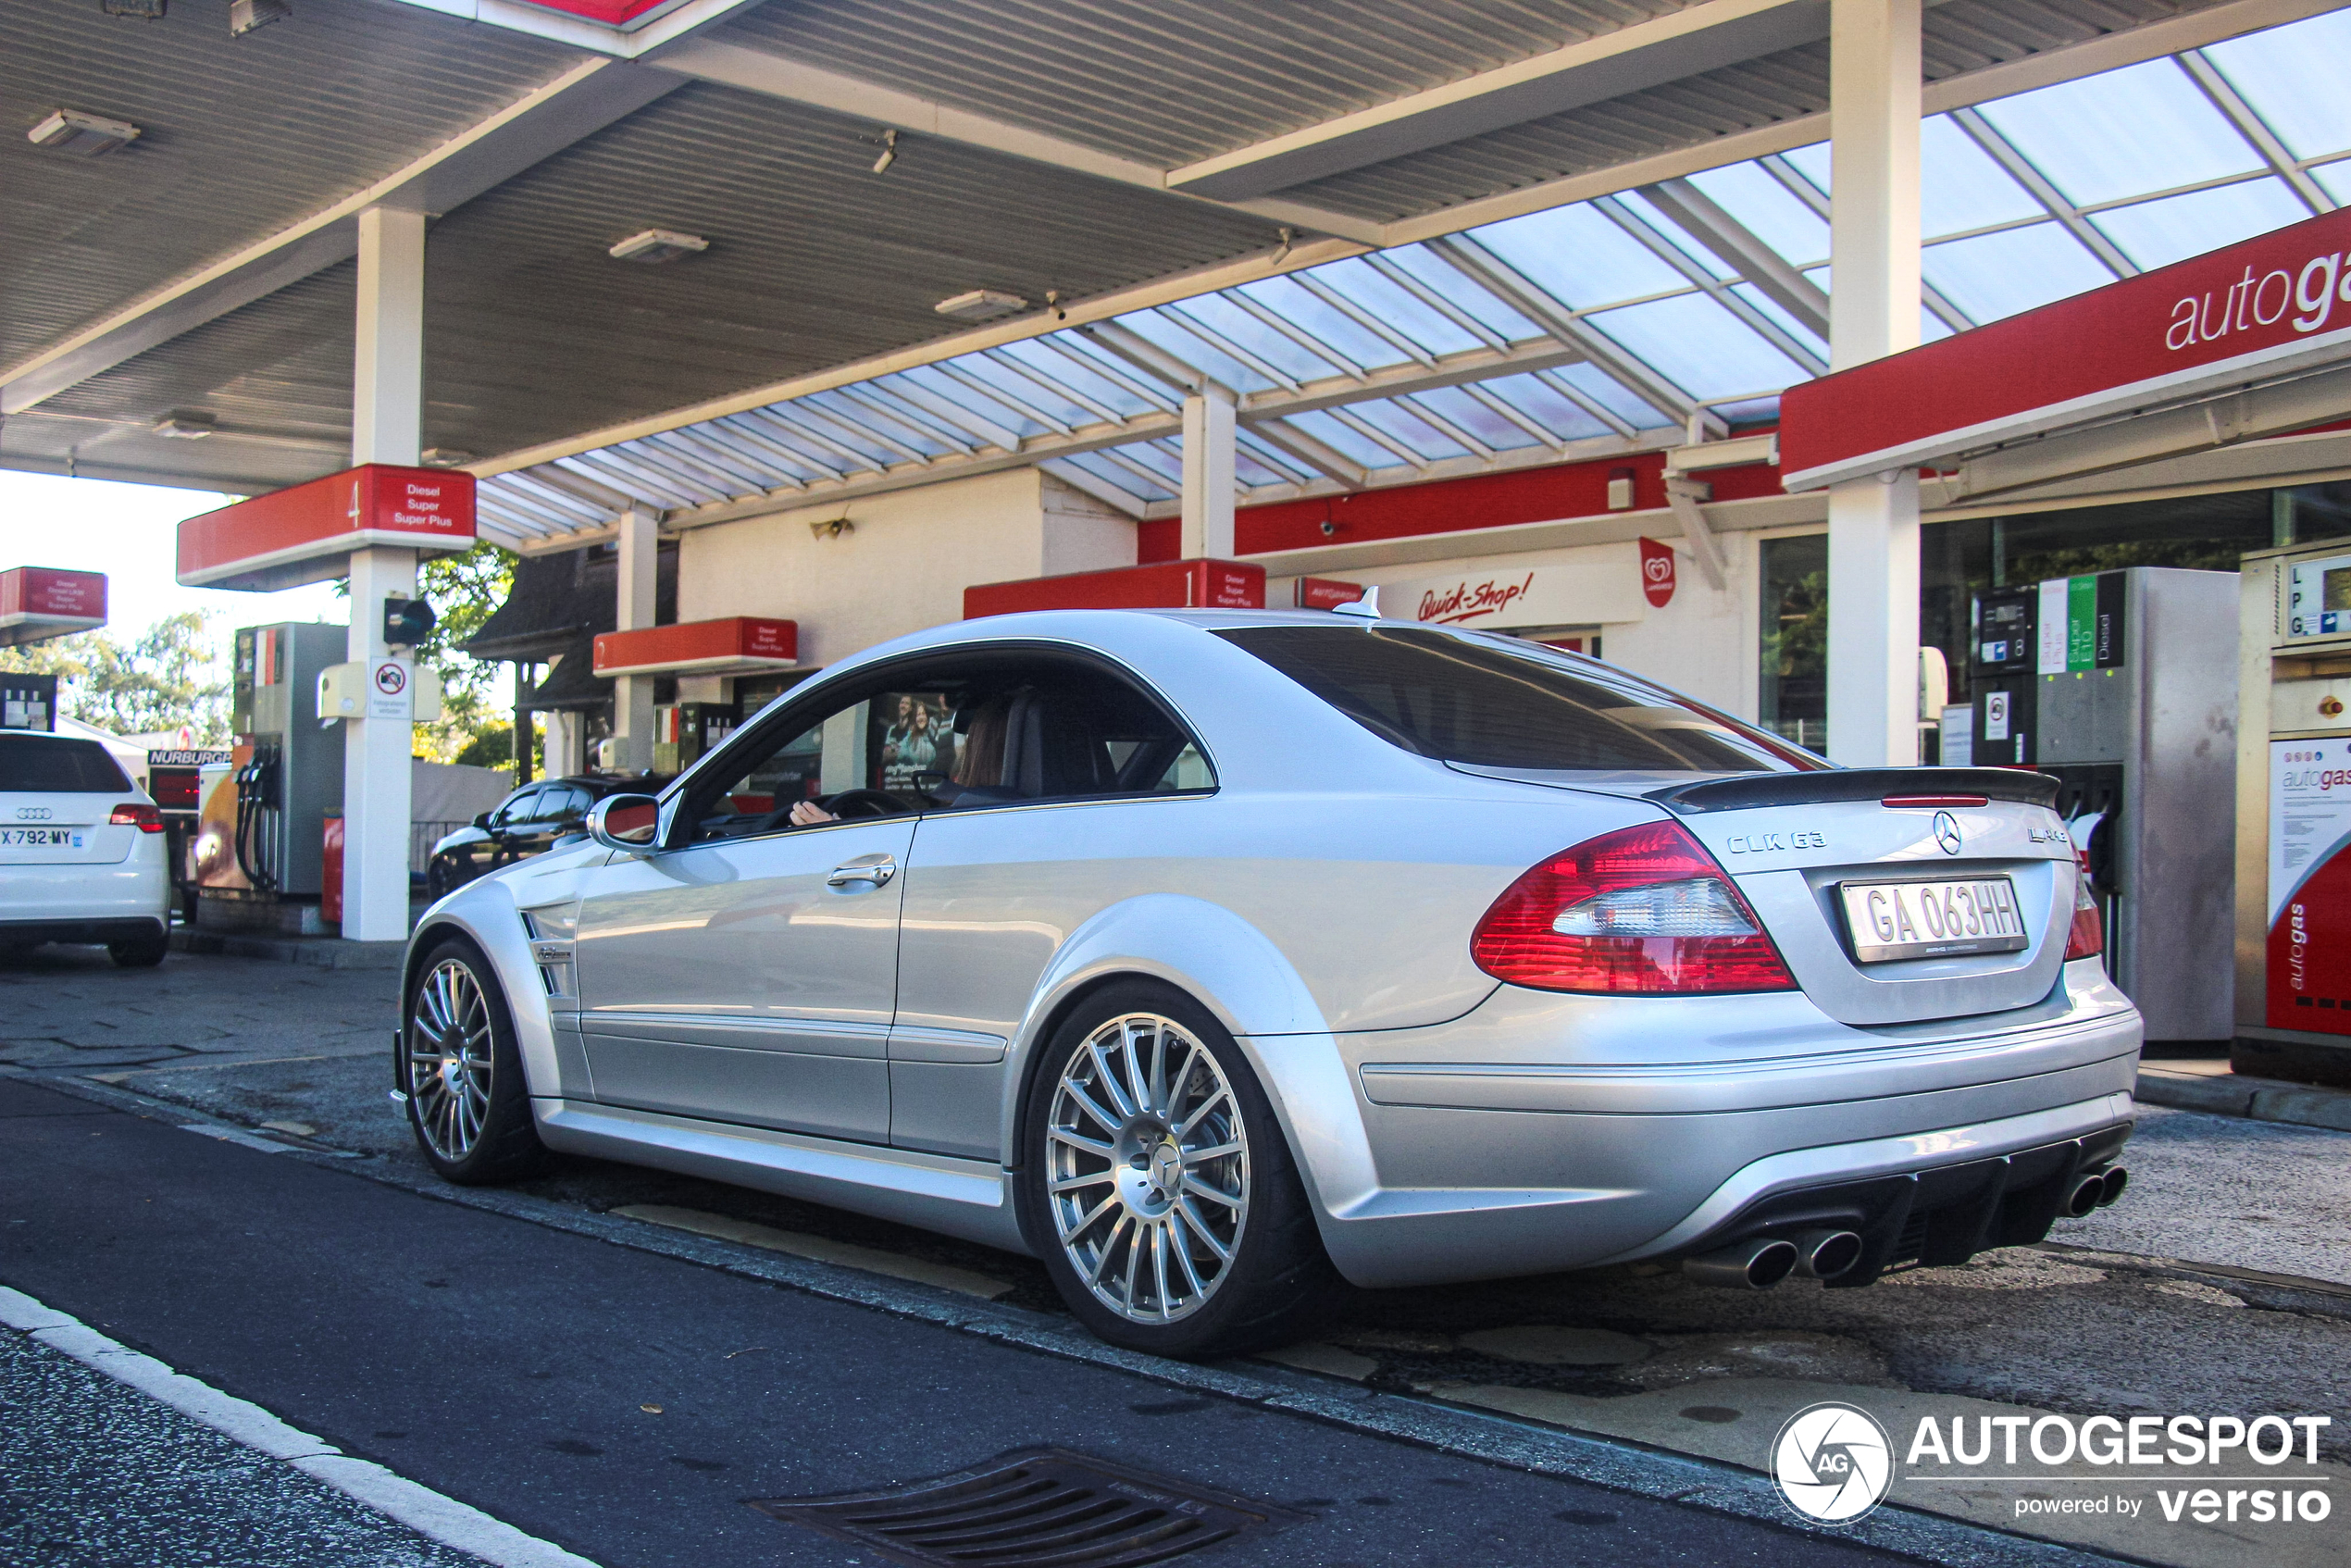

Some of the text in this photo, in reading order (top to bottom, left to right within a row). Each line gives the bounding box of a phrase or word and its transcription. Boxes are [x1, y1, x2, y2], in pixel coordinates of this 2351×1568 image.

[406, 484, 441, 496] Diesel
[348, 480, 360, 528] 4
[407, 498, 440, 511] Super
[394, 512, 453, 528] Super Plus
[1185, 570, 1193, 607] 1
[1225, 574, 1246, 584] Diesel
[1225, 584, 1245, 595] Super
[1217, 594, 1238, 604] Super
[1418, 571, 1534, 622] Quick-Shop!
[2070, 619, 2081, 664] Super
[2098, 614, 2110, 660] Diesel
[597, 641, 605, 668] 2
[1727, 830, 1828, 853] CLK 63
[1867, 884, 2018, 942] GA 063HH
[2289, 903, 2307, 990] autogas
